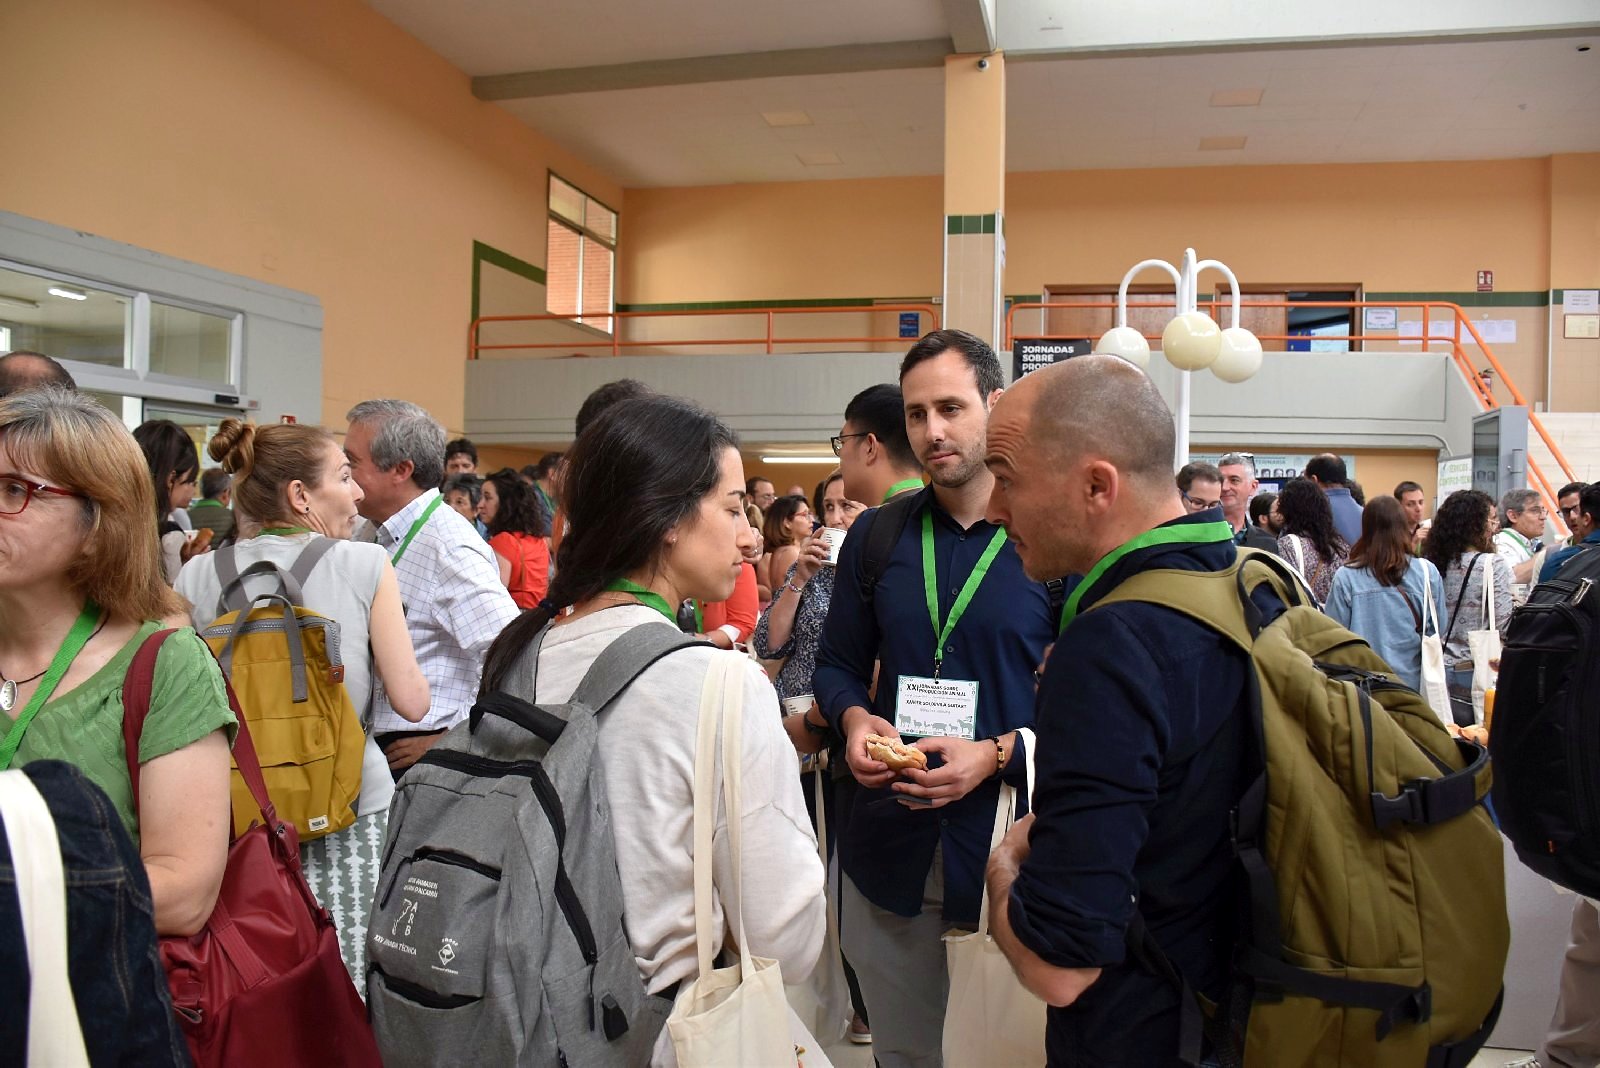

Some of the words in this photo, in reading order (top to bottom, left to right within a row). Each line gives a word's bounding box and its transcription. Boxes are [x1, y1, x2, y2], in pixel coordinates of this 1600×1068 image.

[1022, 345, 1075, 354] JORNADAS
[1022, 354, 1054, 362] SOBRE
[906, 683, 919, 691] XXI
